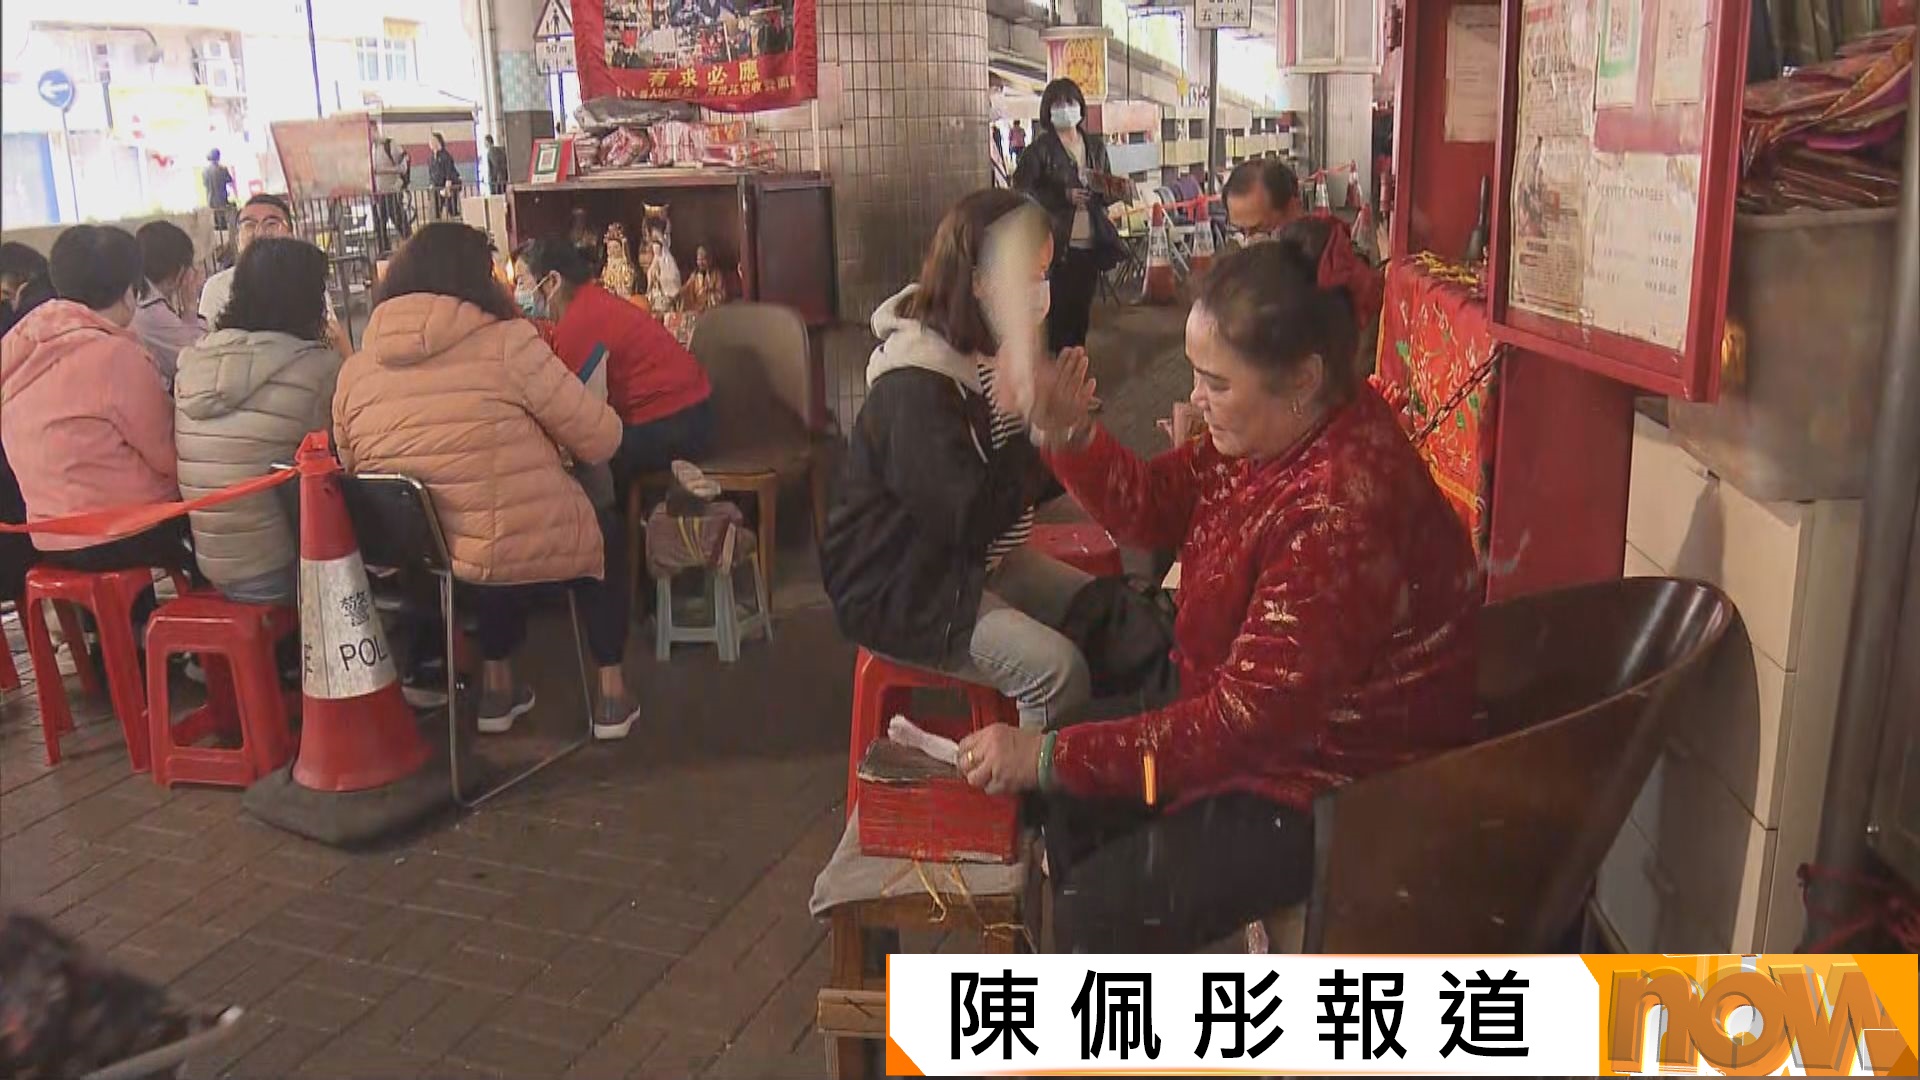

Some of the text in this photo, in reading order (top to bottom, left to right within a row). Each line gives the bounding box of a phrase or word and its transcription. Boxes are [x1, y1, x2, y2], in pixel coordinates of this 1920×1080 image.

[1201, 8, 1244, 22] 五十米
[649, 60, 759, 87] 有求必應
